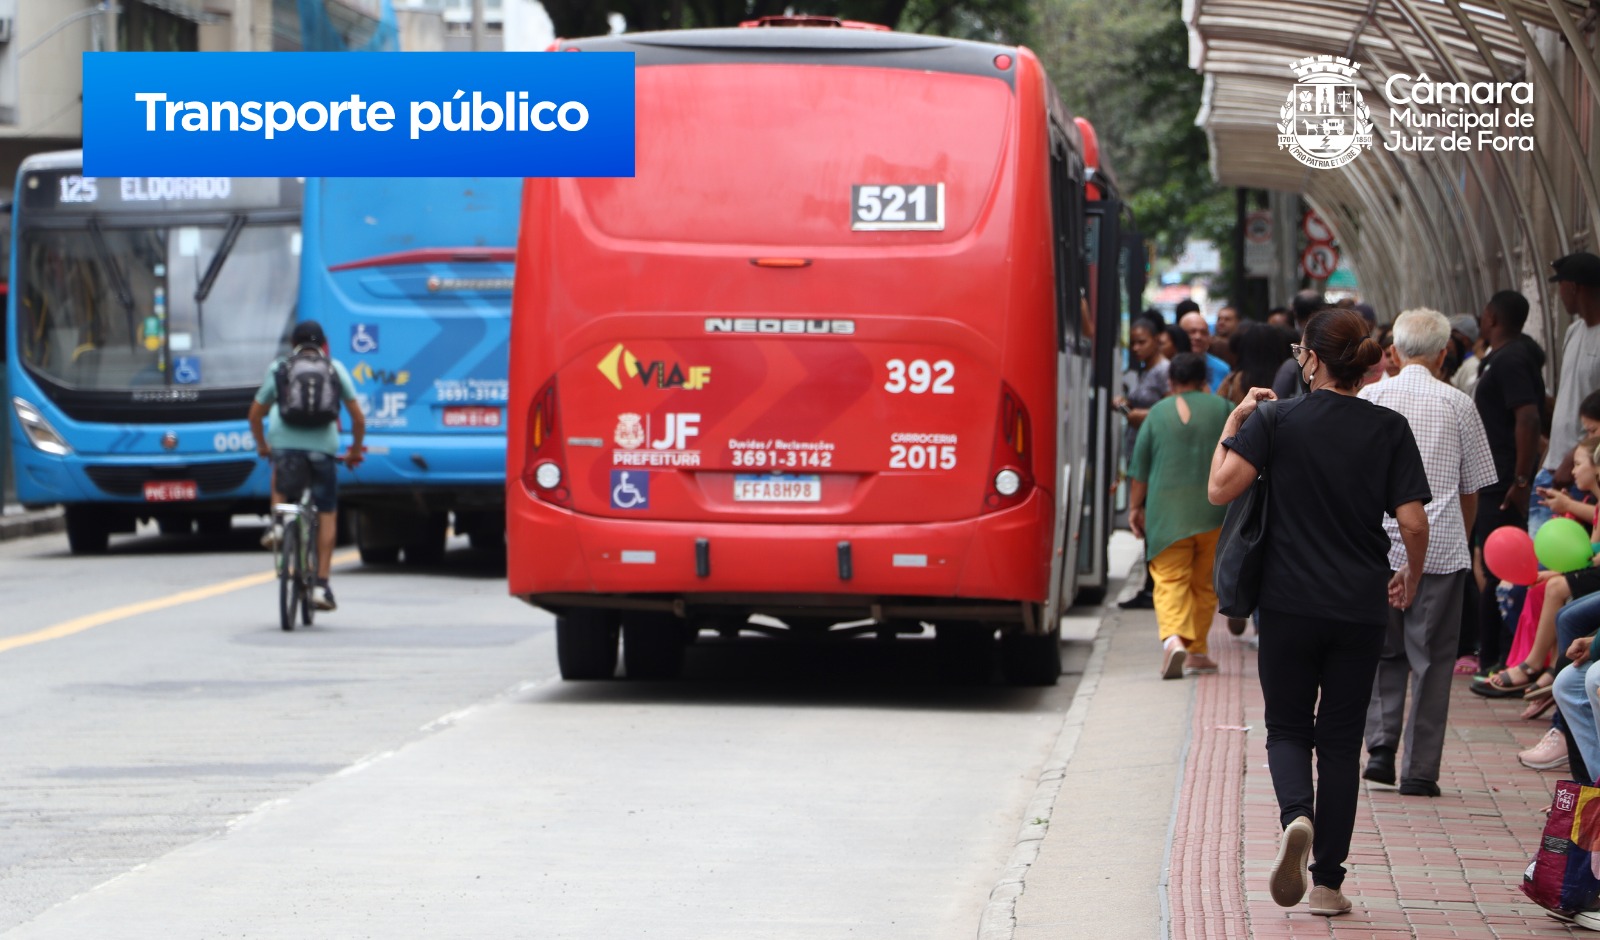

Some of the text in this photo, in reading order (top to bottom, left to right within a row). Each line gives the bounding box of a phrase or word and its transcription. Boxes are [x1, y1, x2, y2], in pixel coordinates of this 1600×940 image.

[60, 175, 232, 203] 125 ELDORADO
[857, 185, 927, 222] 521
[705, 318, 856, 334] NEOBUS
[884, 358, 955, 394] 392
[376, 392, 408, 419] JF
[652, 412, 701, 450] JF
[890, 432, 957, 444] CARROCERIA
[613, 451, 701, 466] PREFEITURA
[731, 450, 832, 467] 3691-3142
[889, 444, 957, 470] 2015
[742, 483, 812, 498] FFA8H98
